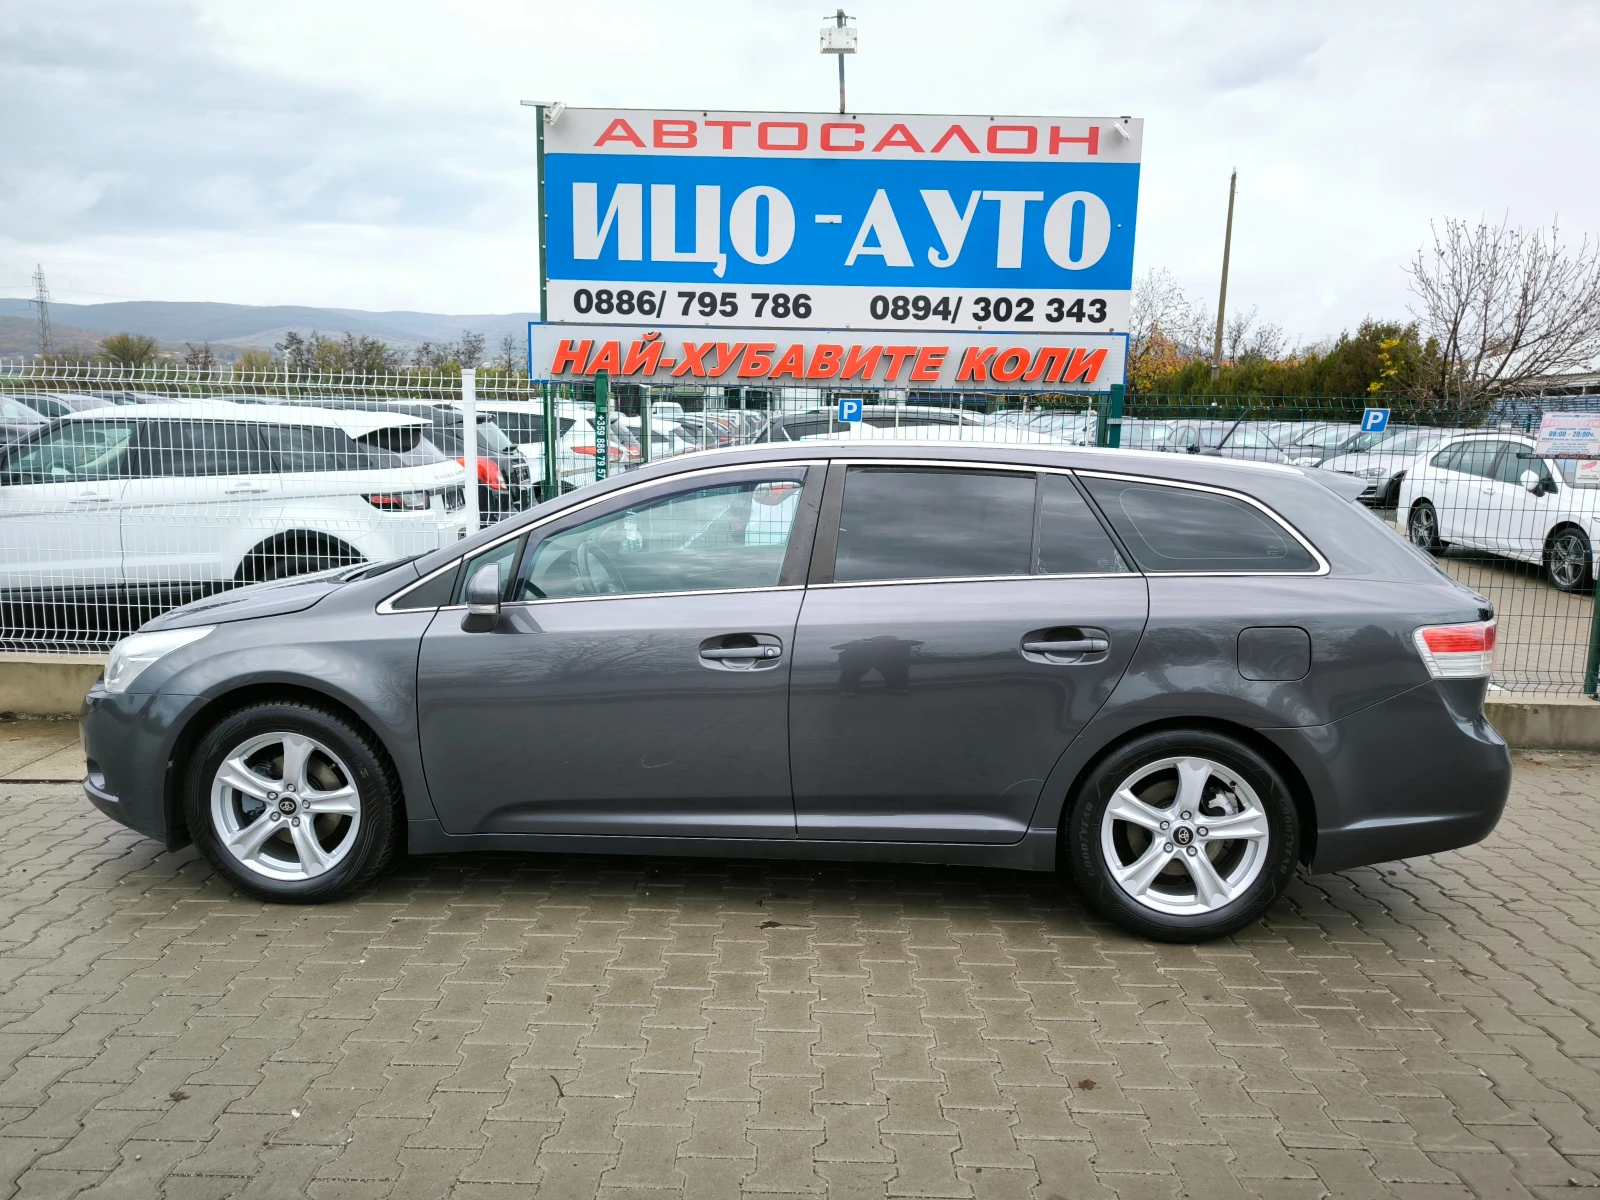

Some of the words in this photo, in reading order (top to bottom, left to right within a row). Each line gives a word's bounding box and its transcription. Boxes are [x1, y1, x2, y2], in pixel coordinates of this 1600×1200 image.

[594, 118, 1100, 156] АВТОСАЛОН
[573, 288, 667, 320] 0886/
[677, 291, 738, 318] 795
[751, 292, 812, 320] 786
[870, 295, 963, 325] 0894/
[972, 296, 1035, 323] 302
[1045, 297, 1107, 324] 343
[550, 332, 948, 382] НАЙ-ХУБАВИТЕ
[957, 346, 1109, 384] КОЛИ
[843, 402, 858, 419] P
[1367, 412, 1384, 430] P
[596, 415, 606, 436] +359
[596, 438, 606, 454] 886
[596, 456, 606, 466] 79
